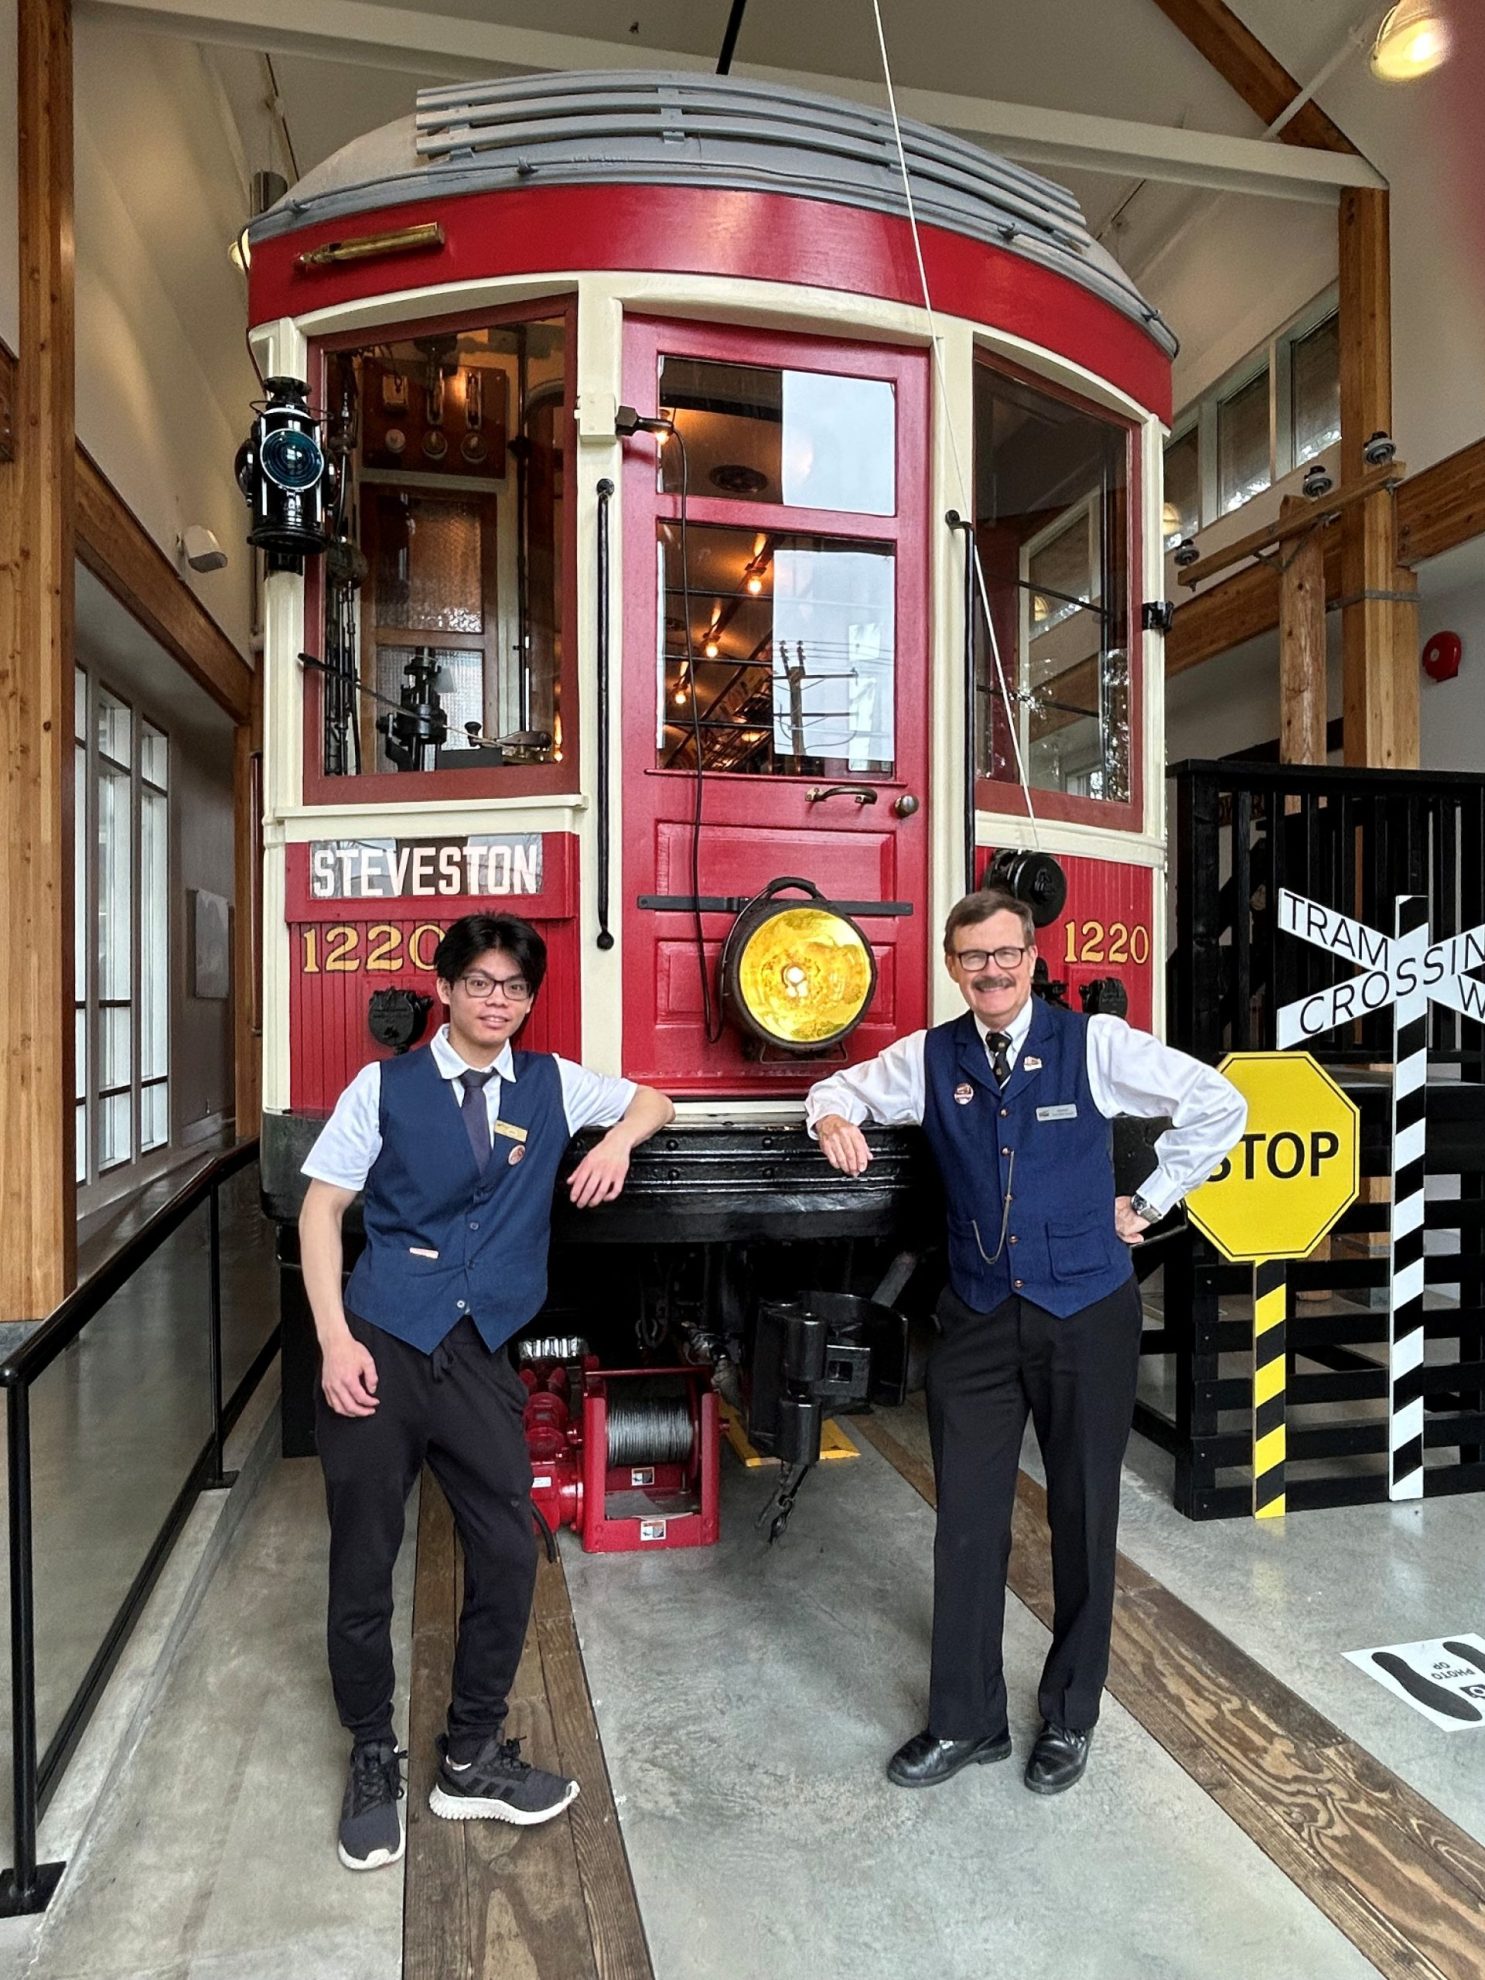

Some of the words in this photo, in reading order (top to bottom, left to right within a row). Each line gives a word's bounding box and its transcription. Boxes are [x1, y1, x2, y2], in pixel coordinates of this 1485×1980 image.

[313, 845, 538, 897] STEVESTON
[303, 923, 446, 973] 1220
[1064, 920, 1150, 965] 1220
[1284, 892, 1388, 972] TRAM
[1431, 1667, 1475, 1680] PHOTO
